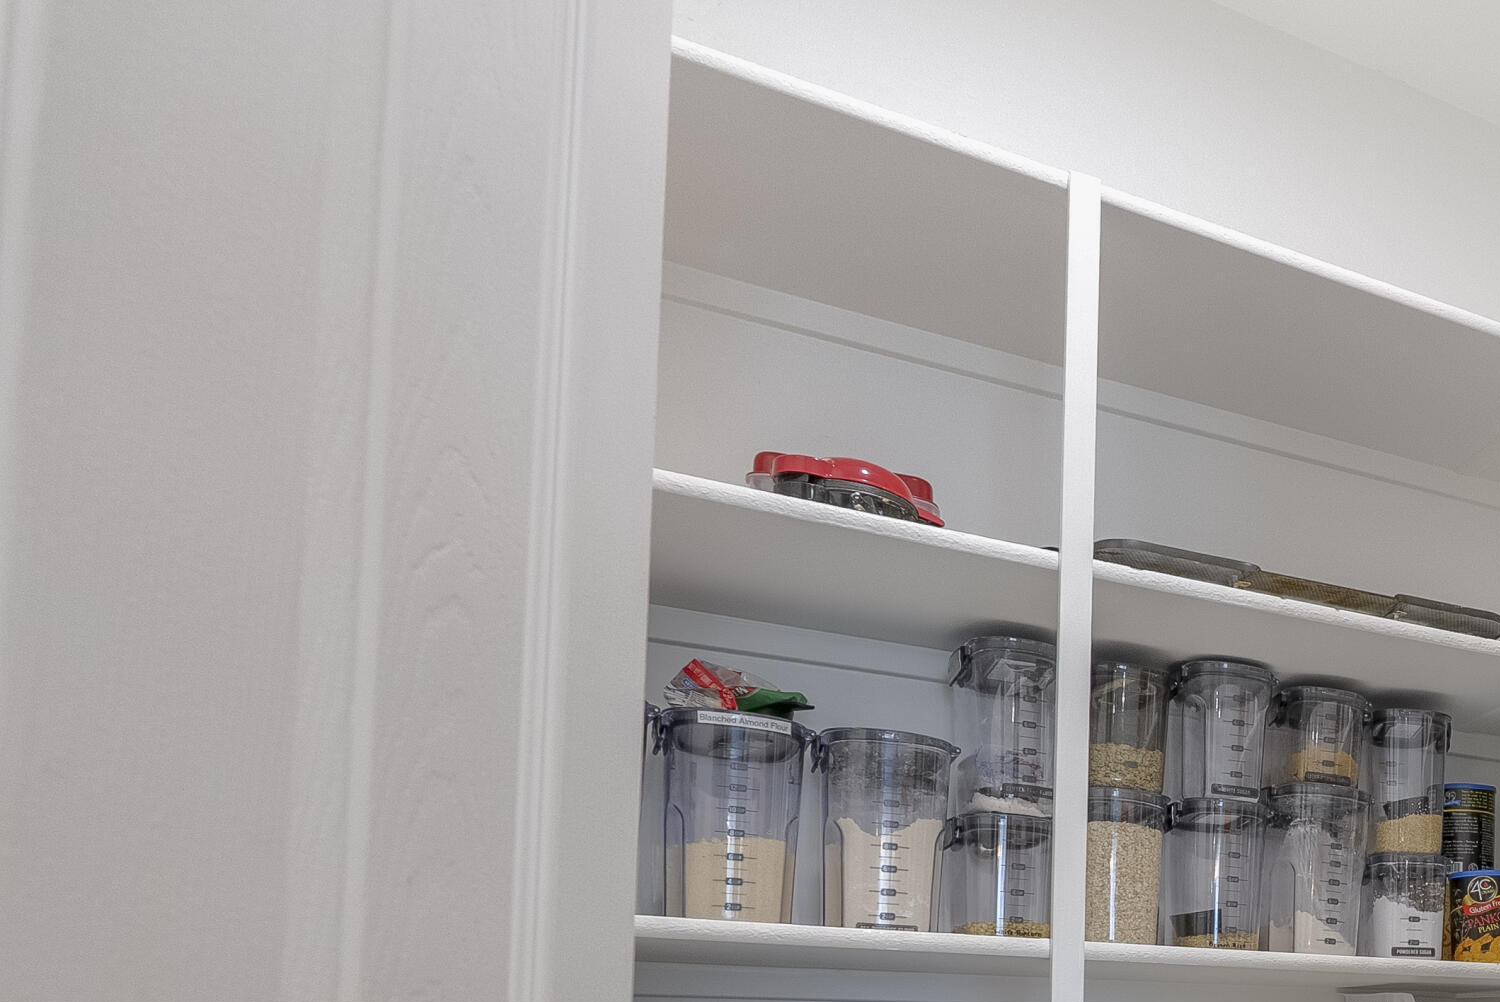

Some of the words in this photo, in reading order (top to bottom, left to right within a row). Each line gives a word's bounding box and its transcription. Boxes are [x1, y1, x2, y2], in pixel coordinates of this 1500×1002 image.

[700, 713, 737, 723] Blanched
[740, 717, 769, 729] Almond
[771, 723, 789, 732] Flour
[1469, 904, 1491, 914] Gluten
[1478, 923, 1499, 933] PLAIN
